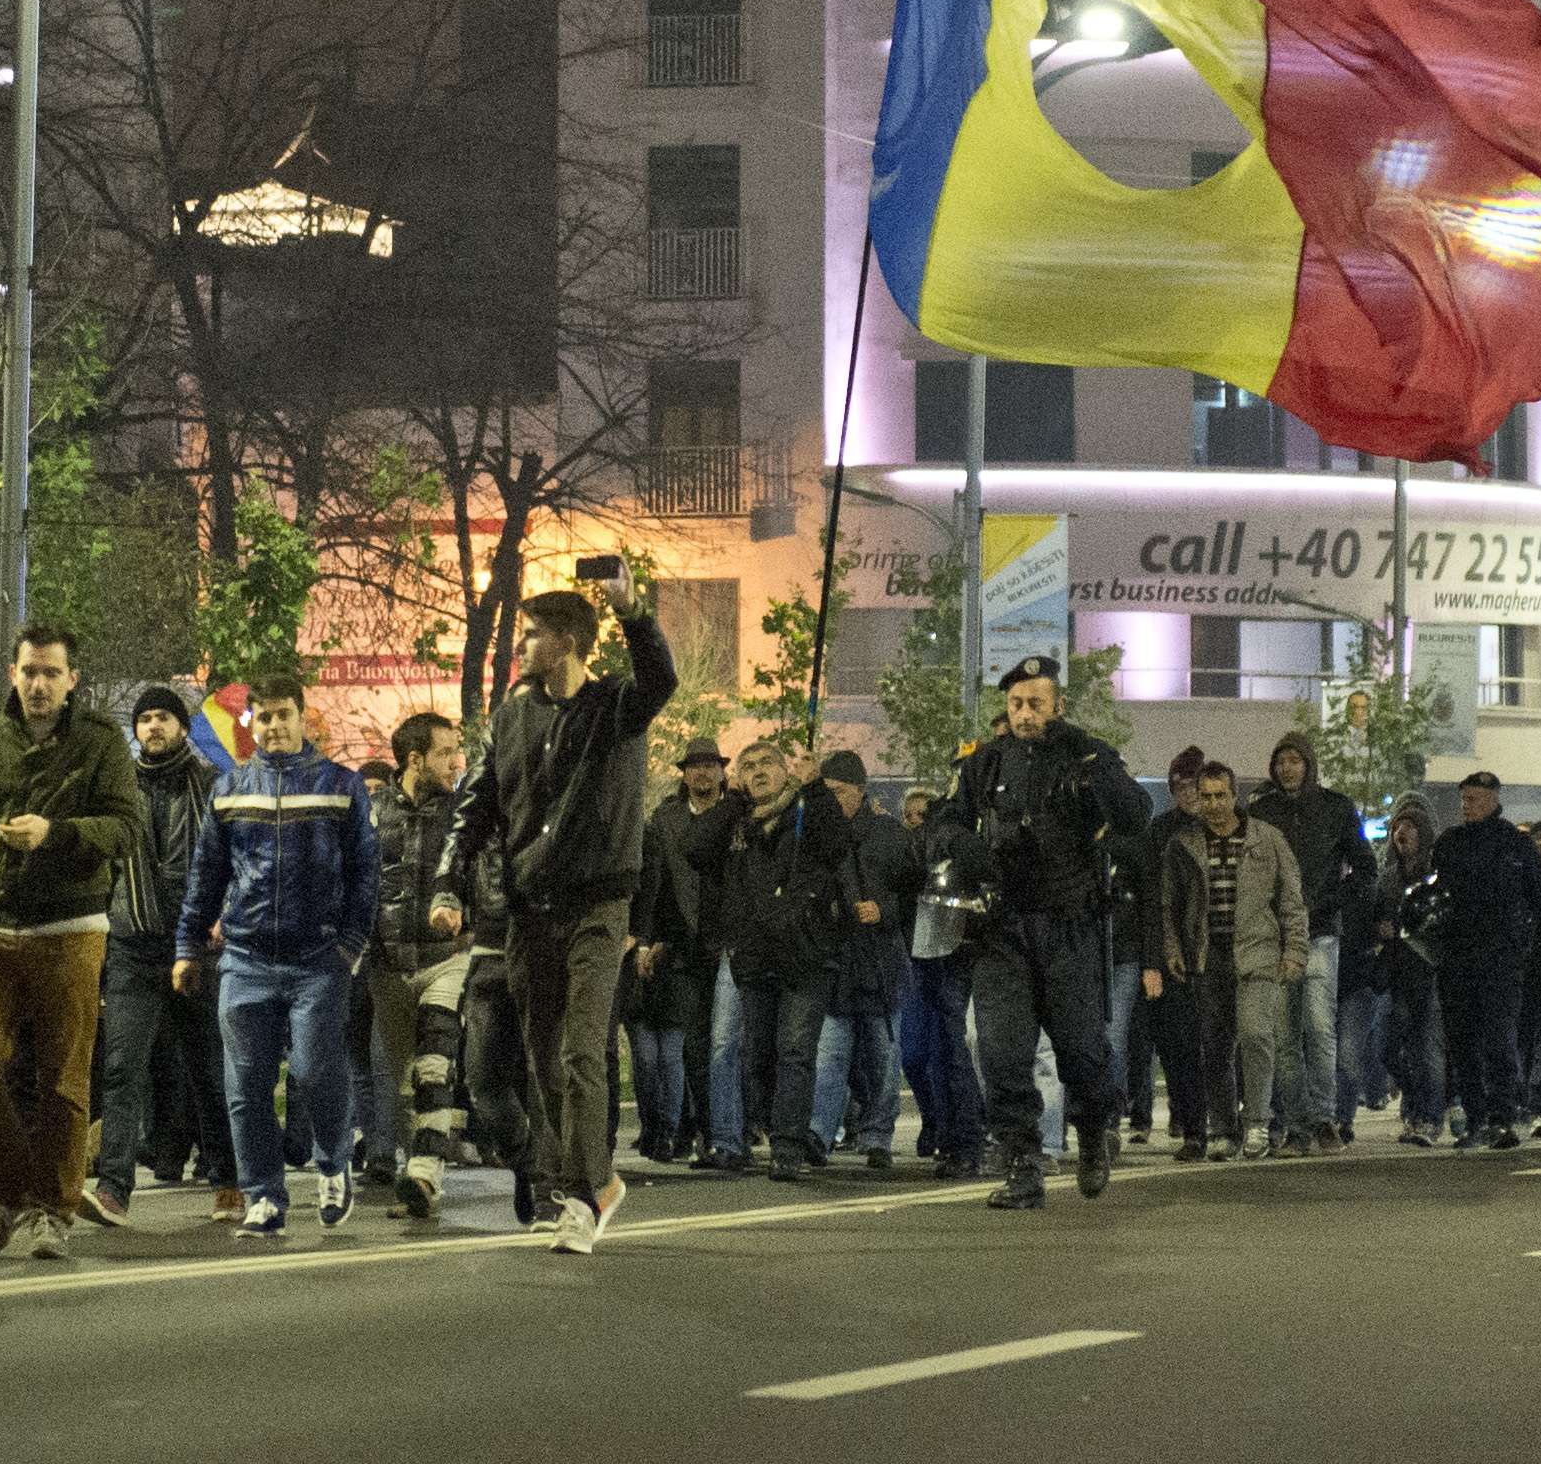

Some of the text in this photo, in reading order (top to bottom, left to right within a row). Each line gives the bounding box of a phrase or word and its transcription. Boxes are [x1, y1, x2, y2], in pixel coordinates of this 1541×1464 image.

[1140, 520, 1247, 576] call
[1259, 527, 1361, 579] +40
[1374, 530, 1457, 582] 747
[1465, 533, 1508, 584] 22
[1110, 577, 1218, 604] business
